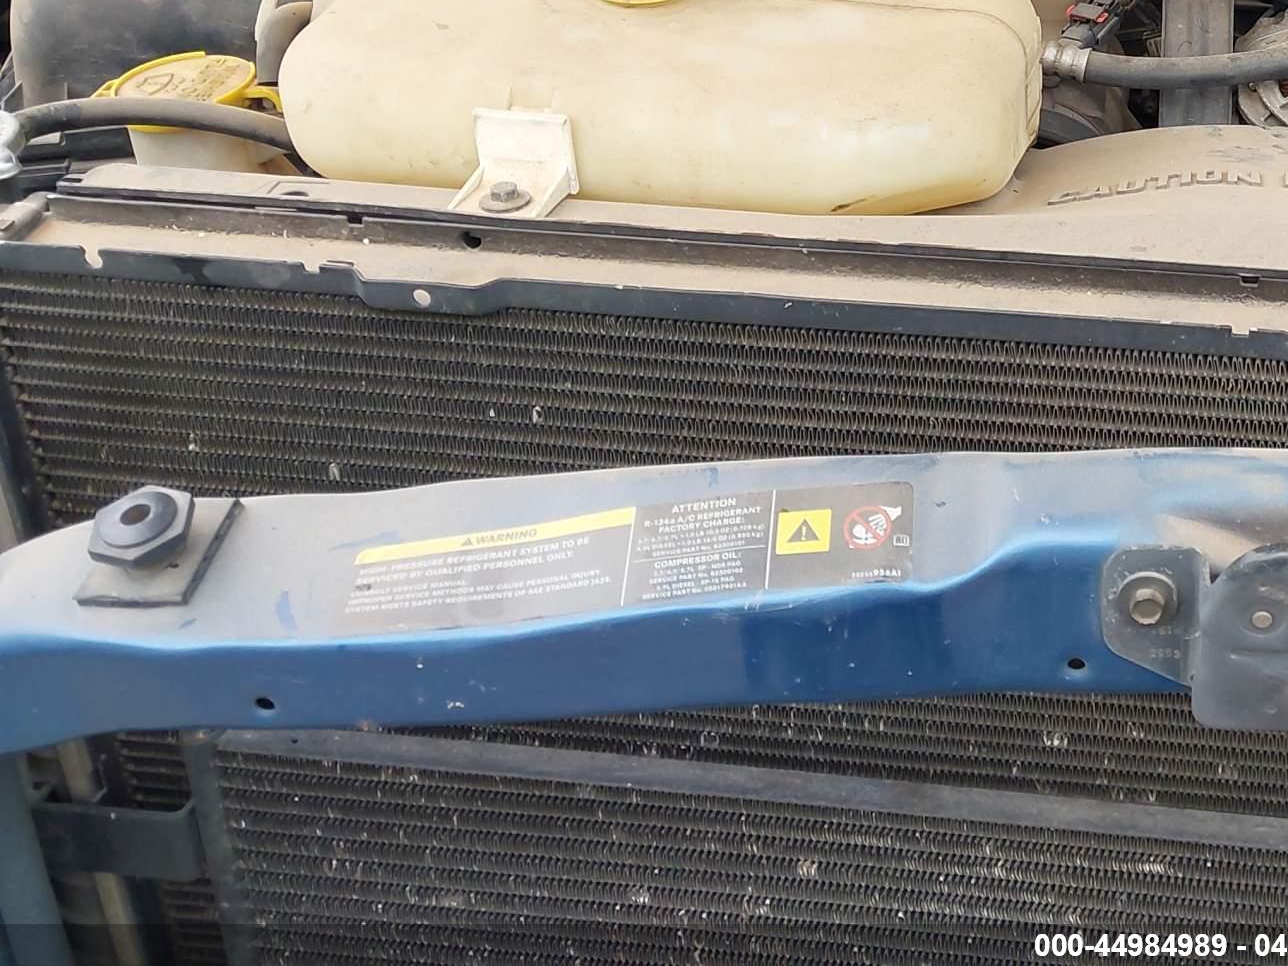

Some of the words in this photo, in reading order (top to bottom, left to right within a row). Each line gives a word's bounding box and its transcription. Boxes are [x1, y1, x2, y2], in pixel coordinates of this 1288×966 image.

[1048, 168, 1264, 206] CAUTION
[671, 497, 737, 514] ATTENTION
[644, 516, 676, 528] R-134a
[677, 513, 697, 524] A/C
[697, 506, 762, 521] REFRIGERANT
[658, 522, 701, 535] FACTORY
[702, 516, 745, 529] CHARGE:
[475, 528, 538, 545] WARNING
[446, 548, 519, 565] REFRIGERANT
[520, 542, 560, 557] SYSTEM
[561, 539, 575, 549] TO
[576, 537, 590, 546] BE
[652, 548, 681, 558] SERVICE
[681, 546, 700, 555] PART
[356, 572, 408, 585] SERVICED
[409, 570, 424, 579] BY
[424, 563, 481, 577] QUALIFIED
[483, 554, 545, 570] PERSONNEL
[654, 553, 720, 570] COMPRESSOR
[476, 583, 494, 593] MAY
[495, 580, 524, 591] CAUSE
[525, 574, 569, 587] PERSONAL
[678, 572, 697, 582] PART
[411, 598, 443, 608] SAFETY
[545, 579, 590, 593] STANDARD
